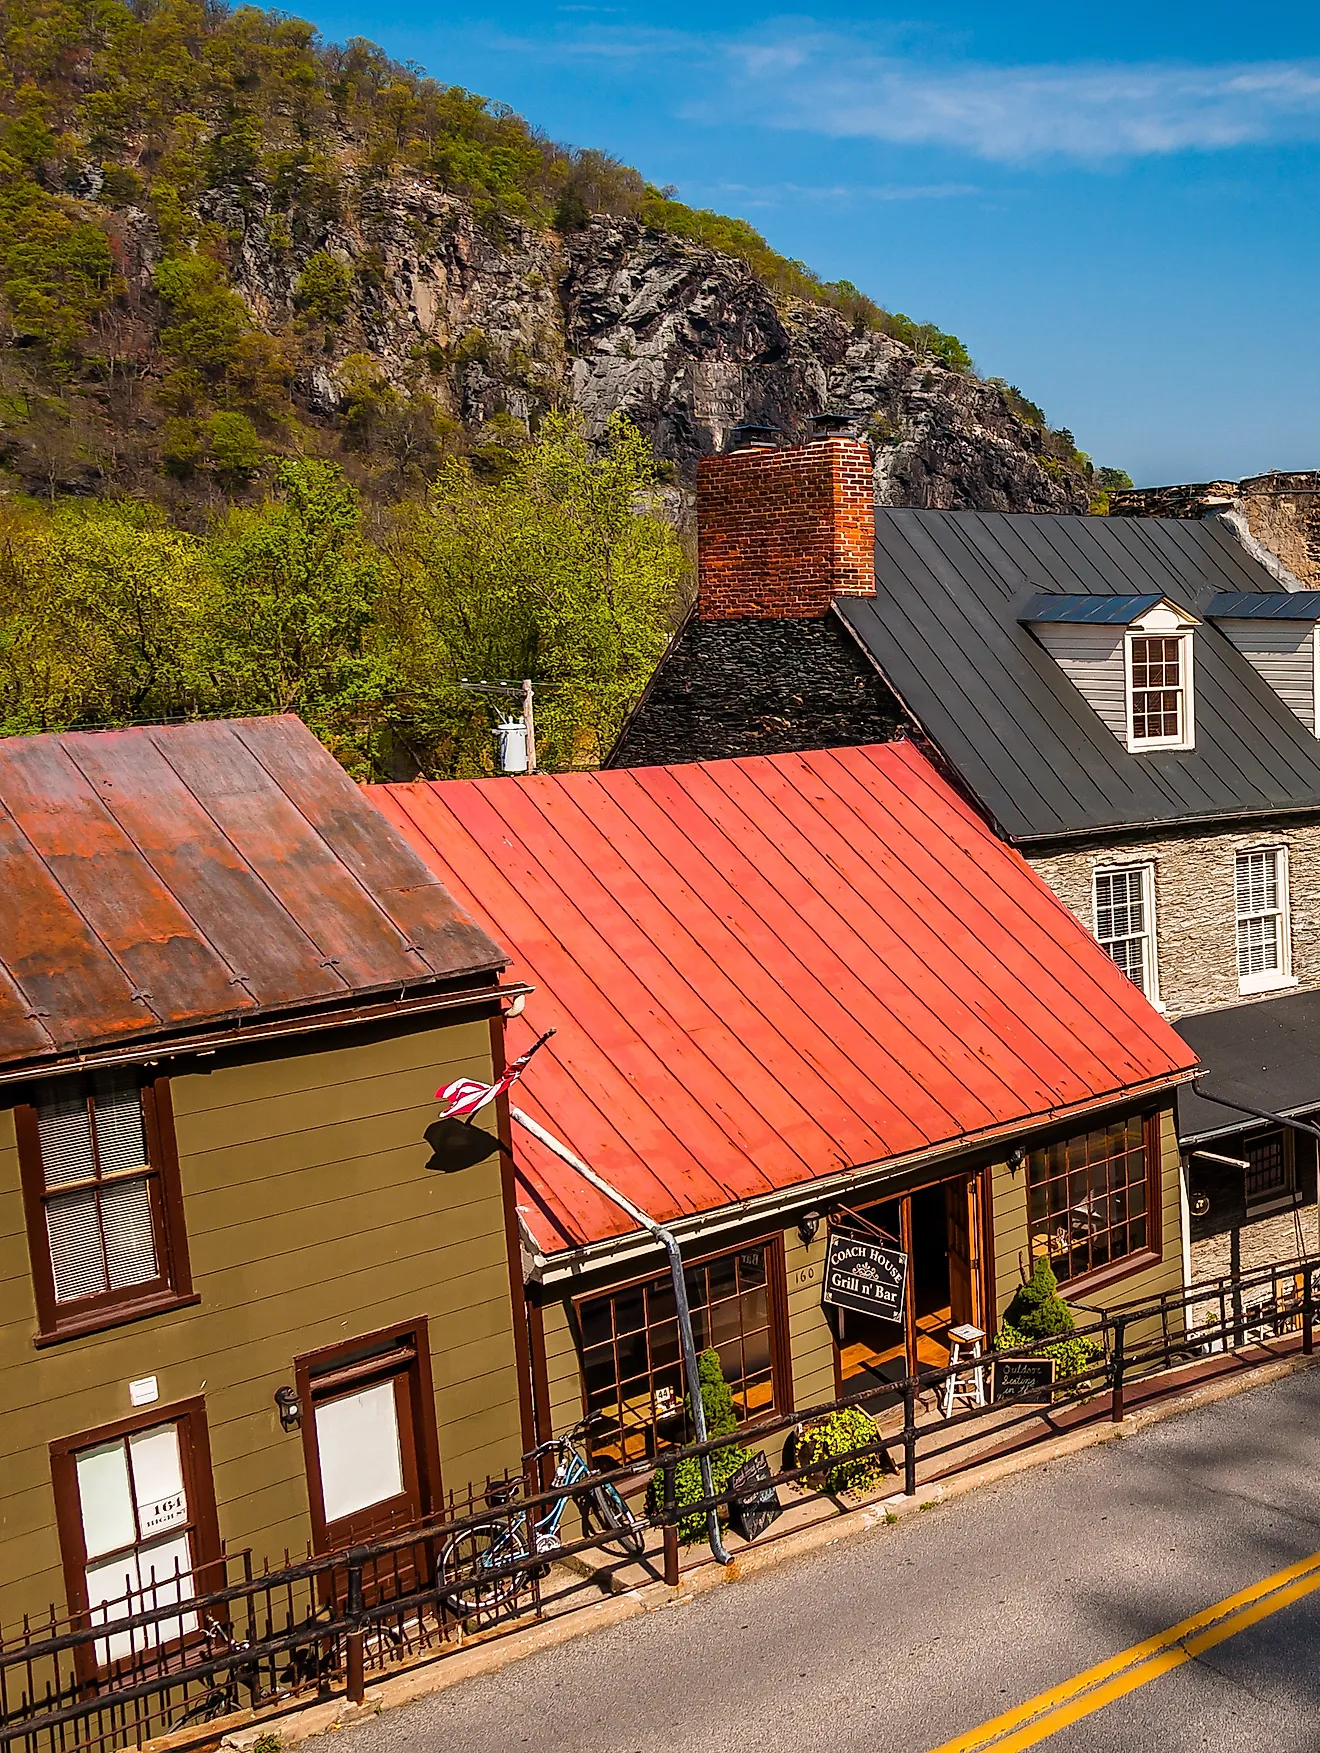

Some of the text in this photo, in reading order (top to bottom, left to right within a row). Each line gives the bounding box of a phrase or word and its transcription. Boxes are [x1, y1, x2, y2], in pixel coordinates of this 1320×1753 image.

[831, 1246, 903, 1284] COACH HOUSE
[795, 1267, 814, 1285] 160
[831, 1273, 898, 1302] Grill n' Bar
[657, 1389, 668, 1398] 44
[154, 1496, 182, 1516] 164
[147, 1513, 174, 1527] HIGH
